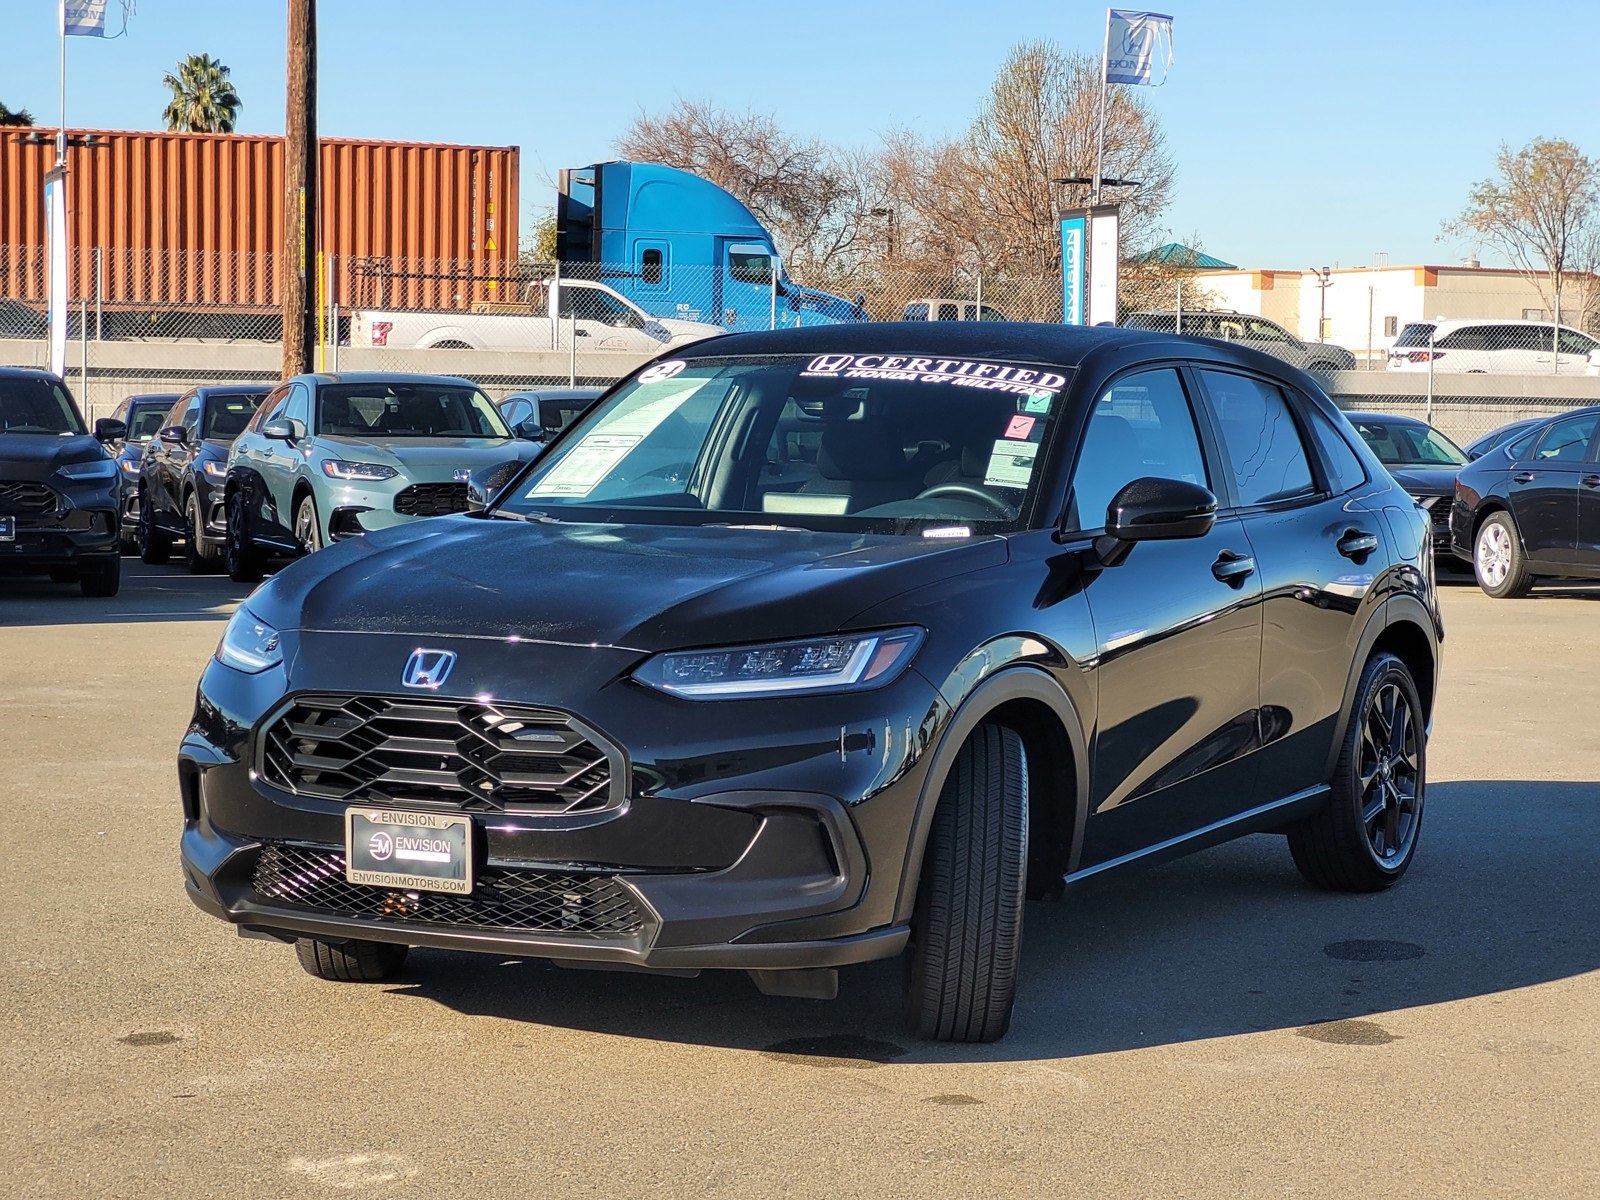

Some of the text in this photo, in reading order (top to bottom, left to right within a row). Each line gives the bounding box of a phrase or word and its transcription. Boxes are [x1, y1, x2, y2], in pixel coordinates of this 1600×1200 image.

[1066, 229, 1075, 322] NVISION
[593, 339, 629, 347] VALLEY
[854, 355, 1066, 388] CERTIFIED
[843, 370, 1054, 397] HONDA OF MILPITAS
[381, 812, 436, 827] ENVISION
[395, 837, 451, 853] ENVISION
[352, 872, 466, 892] ENVISIONMOTORS.COM
